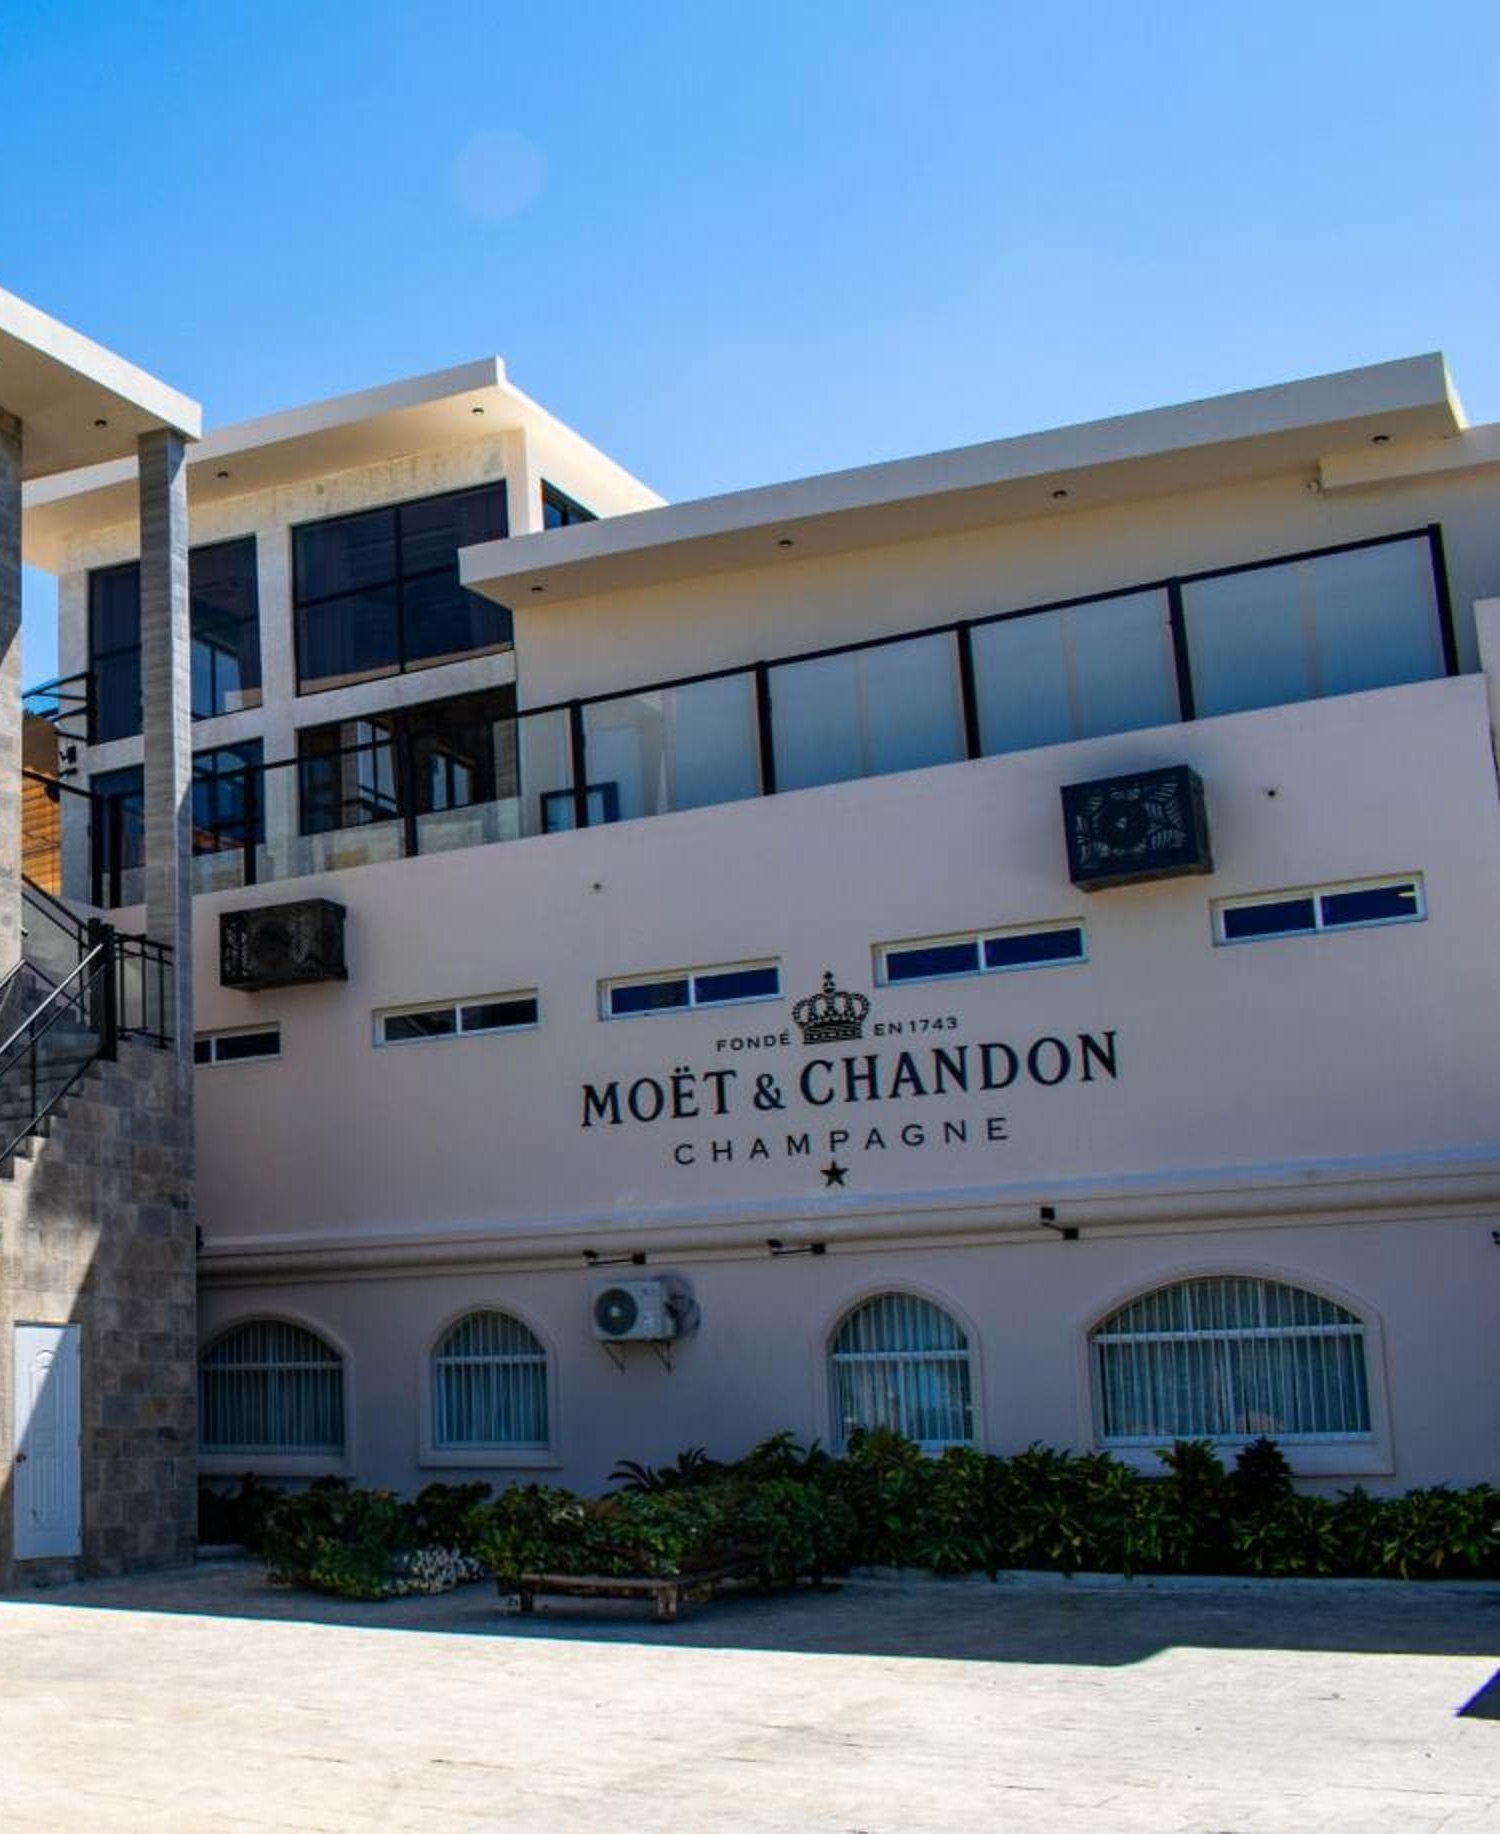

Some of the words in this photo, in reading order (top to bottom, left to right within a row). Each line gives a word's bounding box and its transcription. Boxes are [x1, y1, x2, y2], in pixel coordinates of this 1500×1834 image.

[715, 1028, 792, 1053] FONDÉ
[873, 1021, 904, 1037] EN
[908, 1015, 959, 1034] 1743
[579, 1065, 738, 1129] MOËT
[752, 1072, 788, 1112] &
[798, 1029, 1119, 1108] CHANDON
[673, 1116, 1011, 1167] CHAMPAGNE
